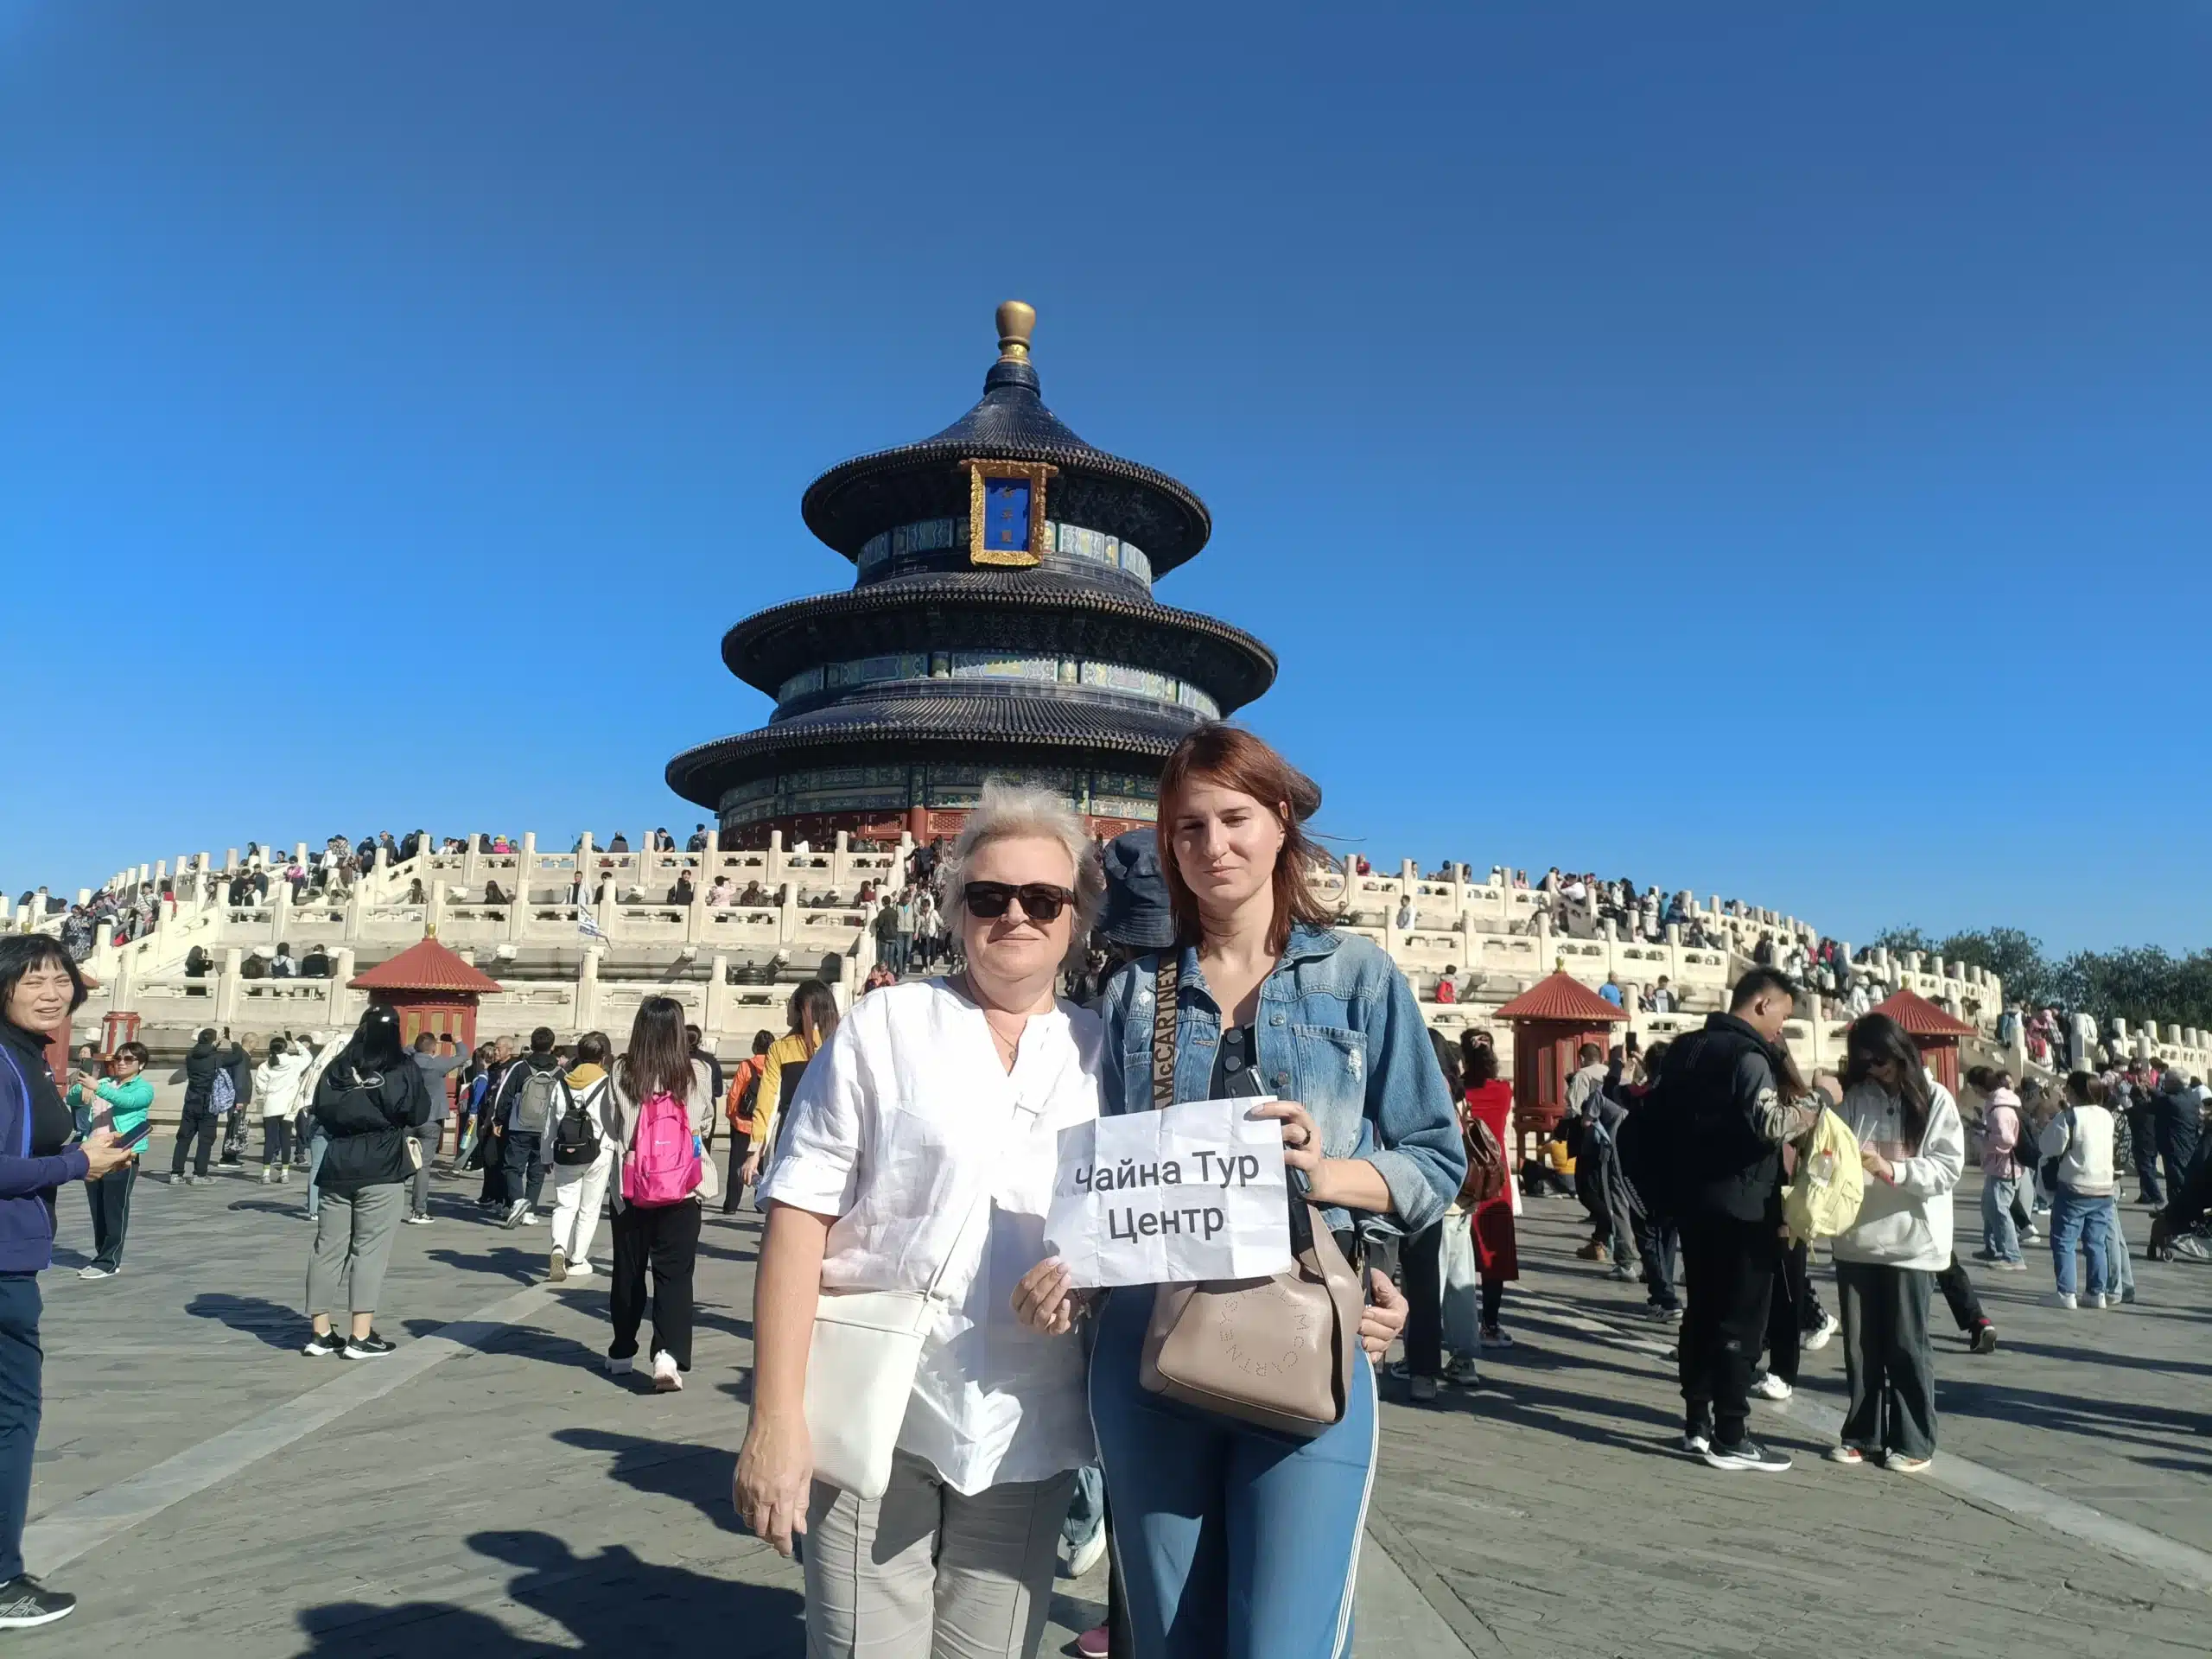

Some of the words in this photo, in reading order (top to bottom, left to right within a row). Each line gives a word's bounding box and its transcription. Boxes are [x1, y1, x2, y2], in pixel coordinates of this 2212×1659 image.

[1075, 1158, 1183, 1193] Чайна
[1192, 1151, 1260, 1189] Тур
[1109, 1207, 1224, 1244] Центр
